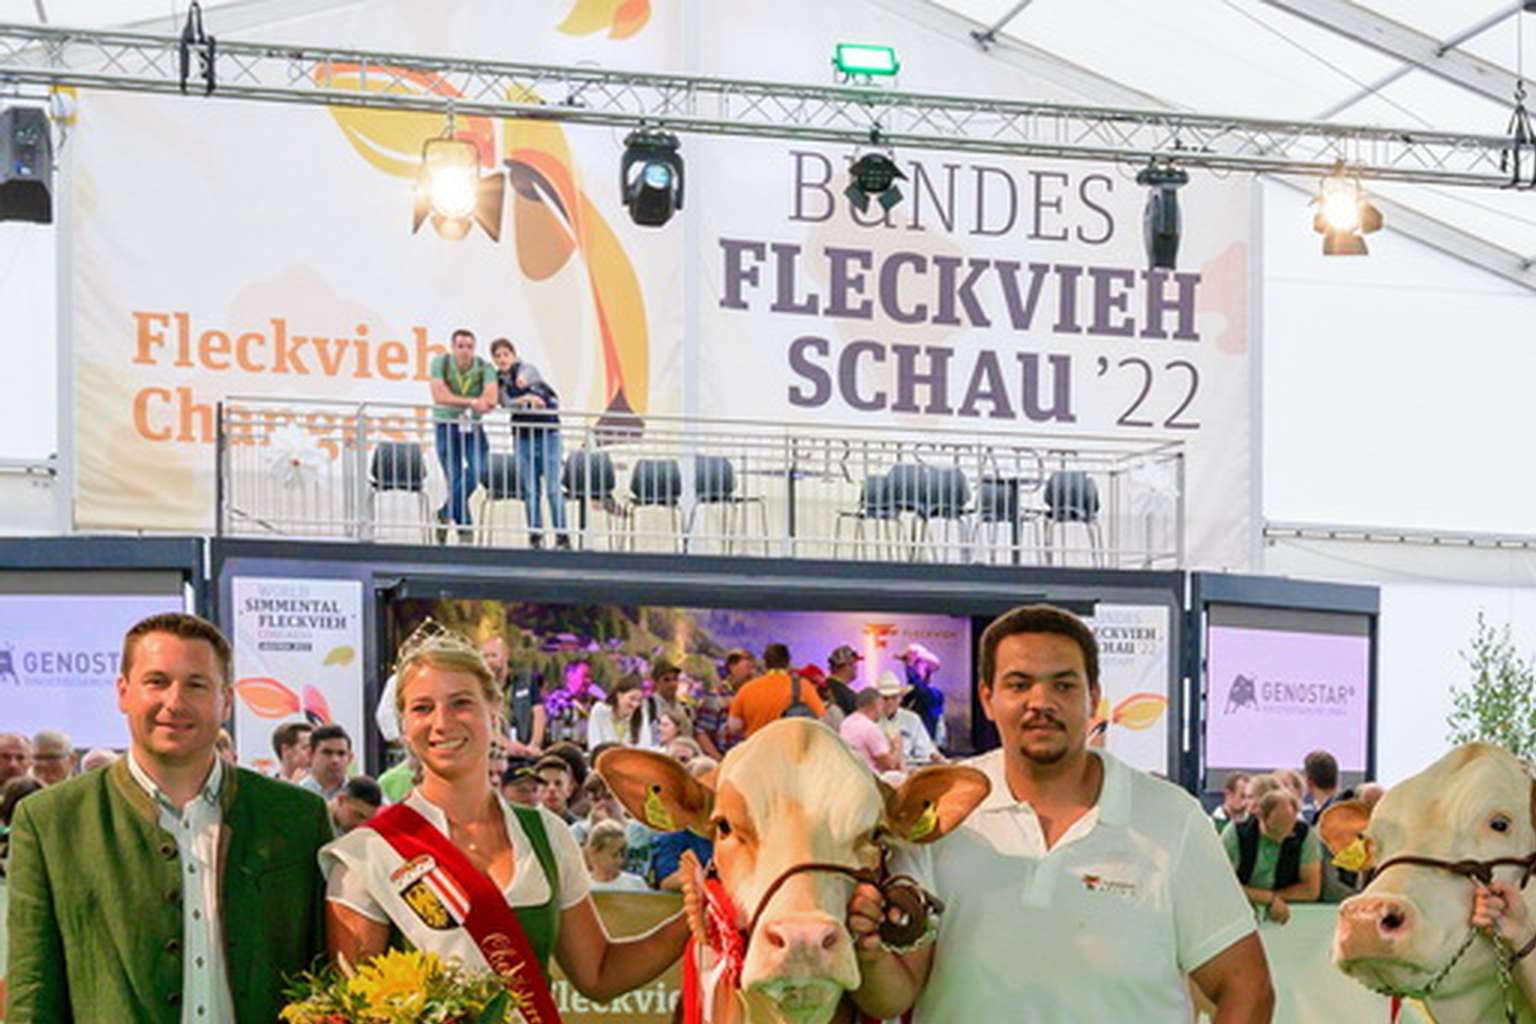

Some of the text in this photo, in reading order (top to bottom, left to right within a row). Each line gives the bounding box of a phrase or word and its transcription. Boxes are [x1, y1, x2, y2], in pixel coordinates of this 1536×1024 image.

[718, 238, 1202, 342] FLECKVIEH
[787, 335, 1077, 423] SCHAU
[244, 598, 342, 614] SIMMENTAL
[258, 614, 347, 629] FLECKVIEH
[22, 651, 120, 675] GENOST
[545, 979, 681, 1013] leckvi
